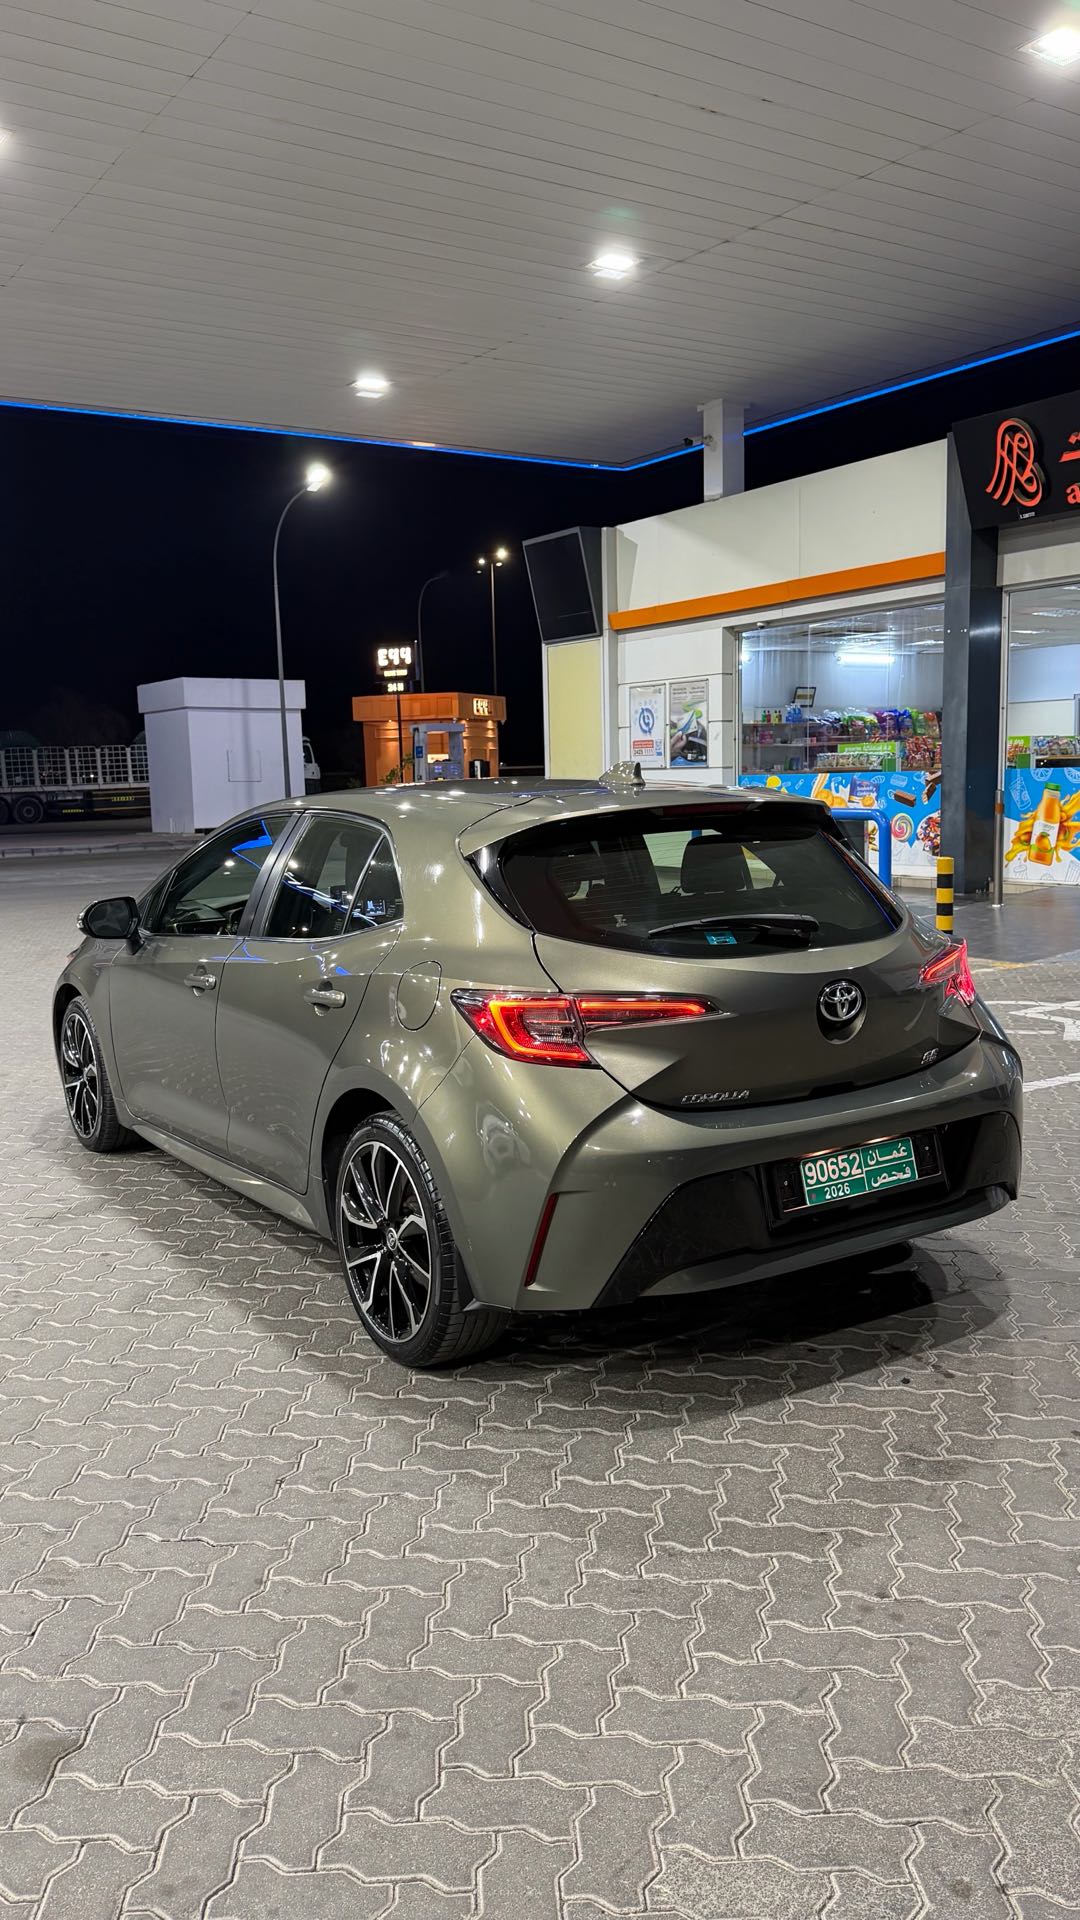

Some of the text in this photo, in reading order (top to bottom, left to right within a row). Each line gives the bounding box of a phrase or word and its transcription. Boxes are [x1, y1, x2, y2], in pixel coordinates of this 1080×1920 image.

[680, 1090, 750, 1105] COROLLA
[804, 1152, 862, 1185] 90652
[871, 1163, 912, 1187] فحص
[824, 1182, 851, 1200] 2026
